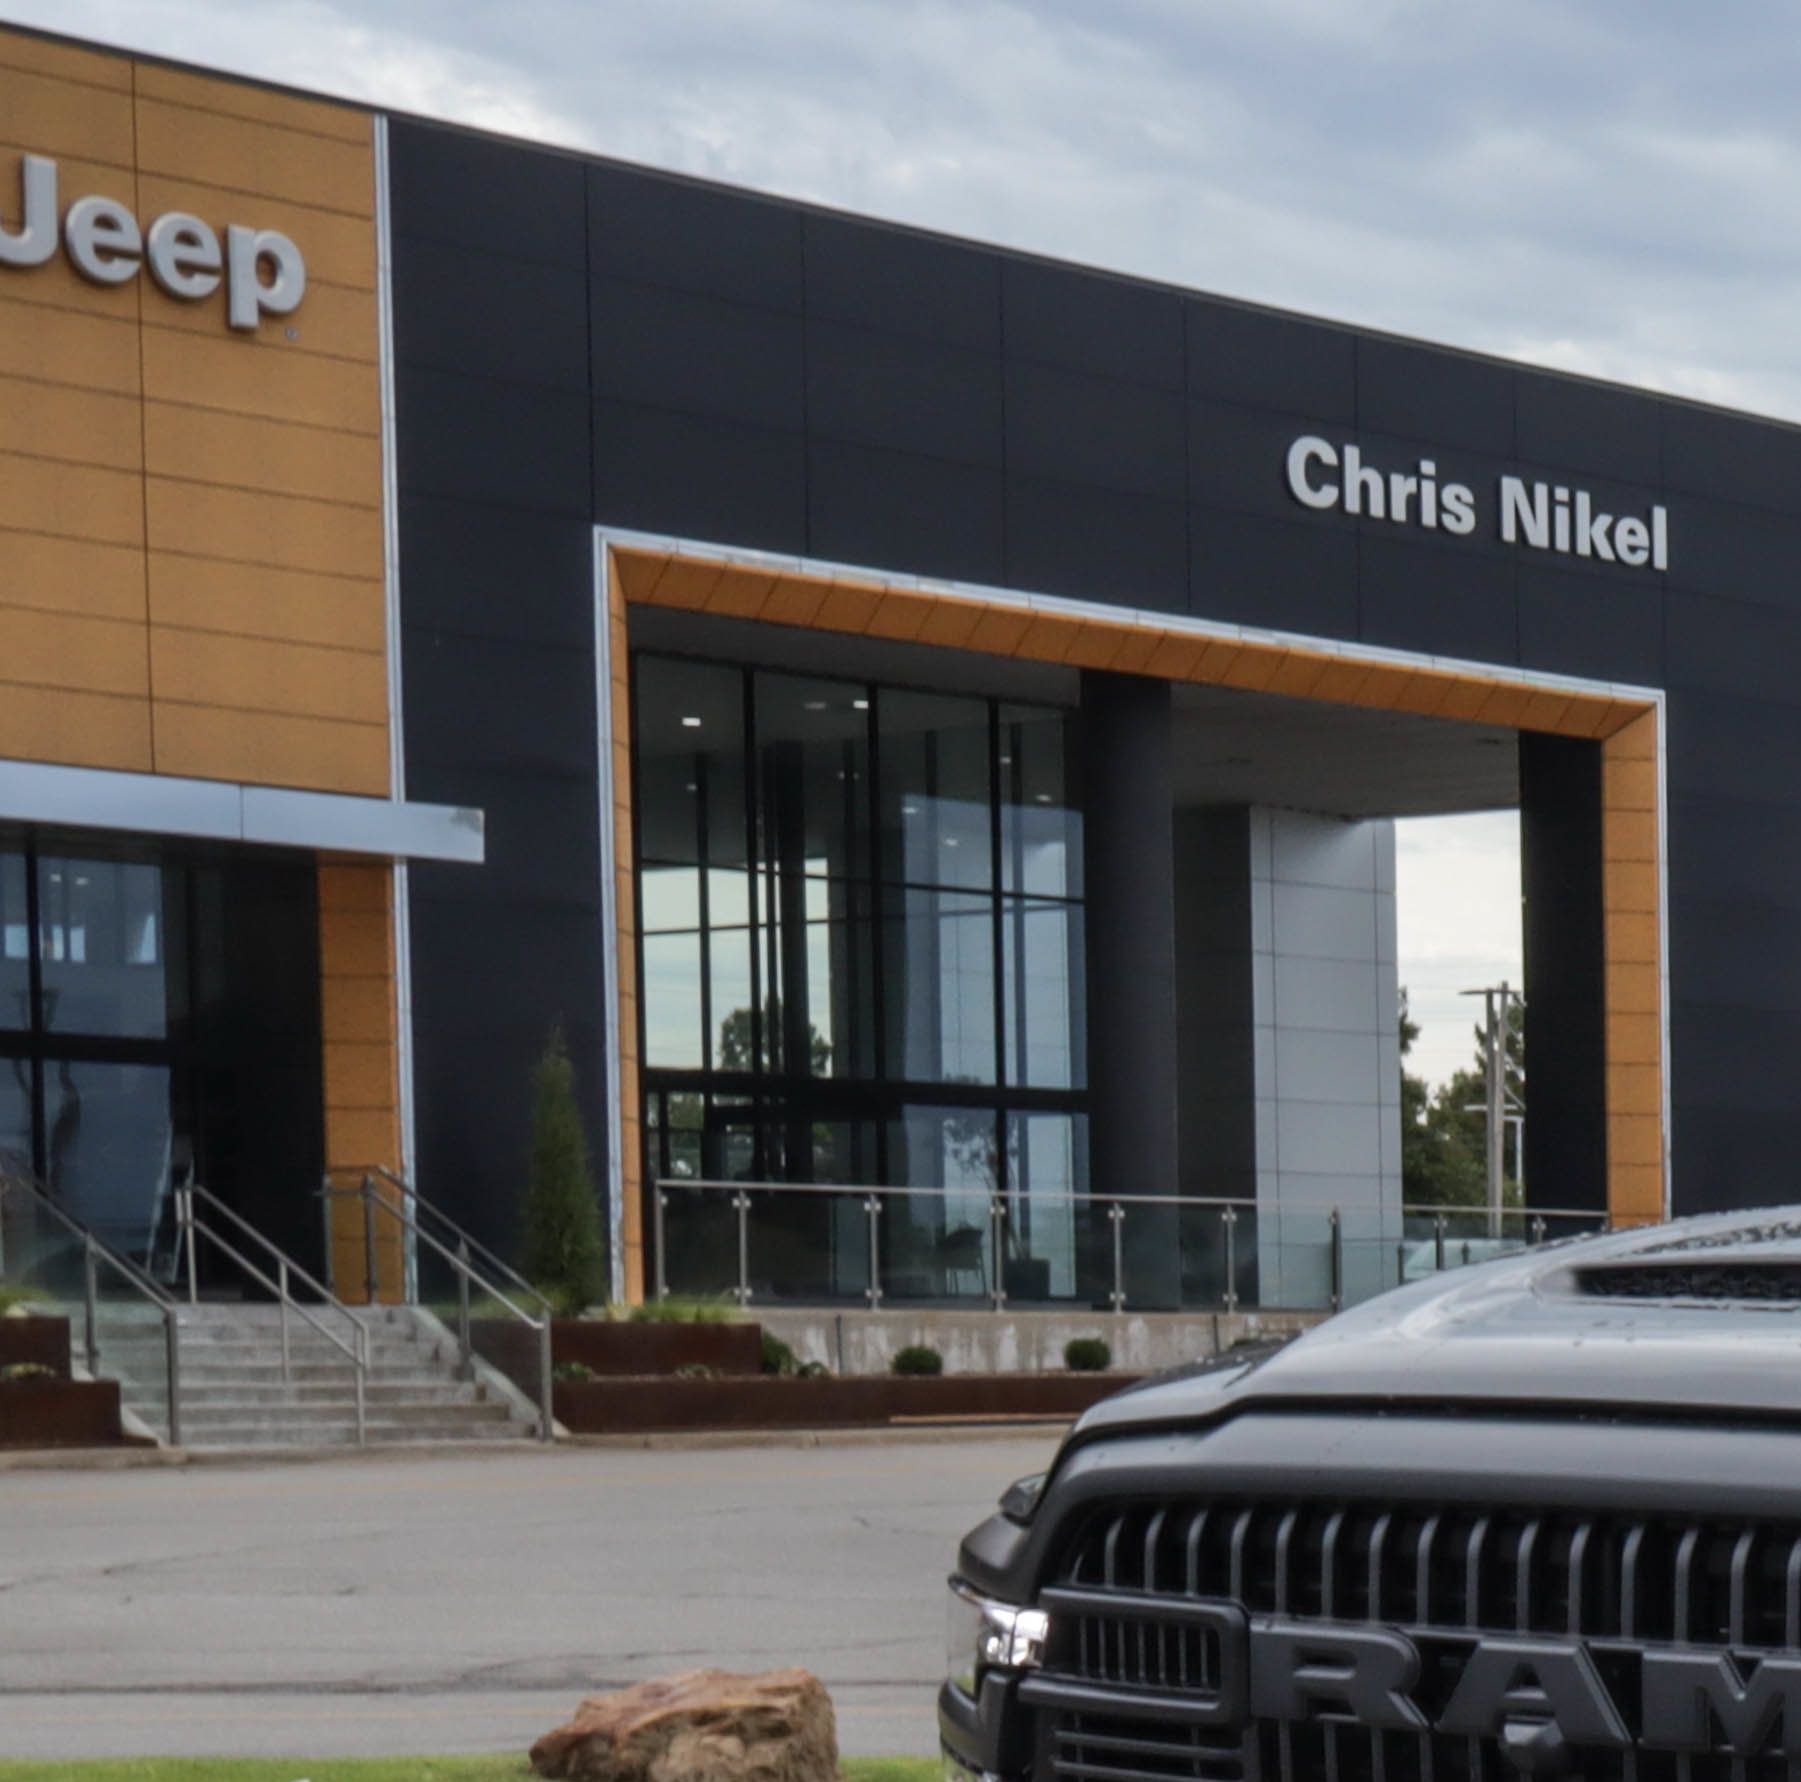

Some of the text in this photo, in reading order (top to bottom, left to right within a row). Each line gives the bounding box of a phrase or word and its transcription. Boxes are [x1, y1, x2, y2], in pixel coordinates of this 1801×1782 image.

[0, 154, 307, 329] Jeep
[1287, 435, 1668, 571] Chris Nikel
